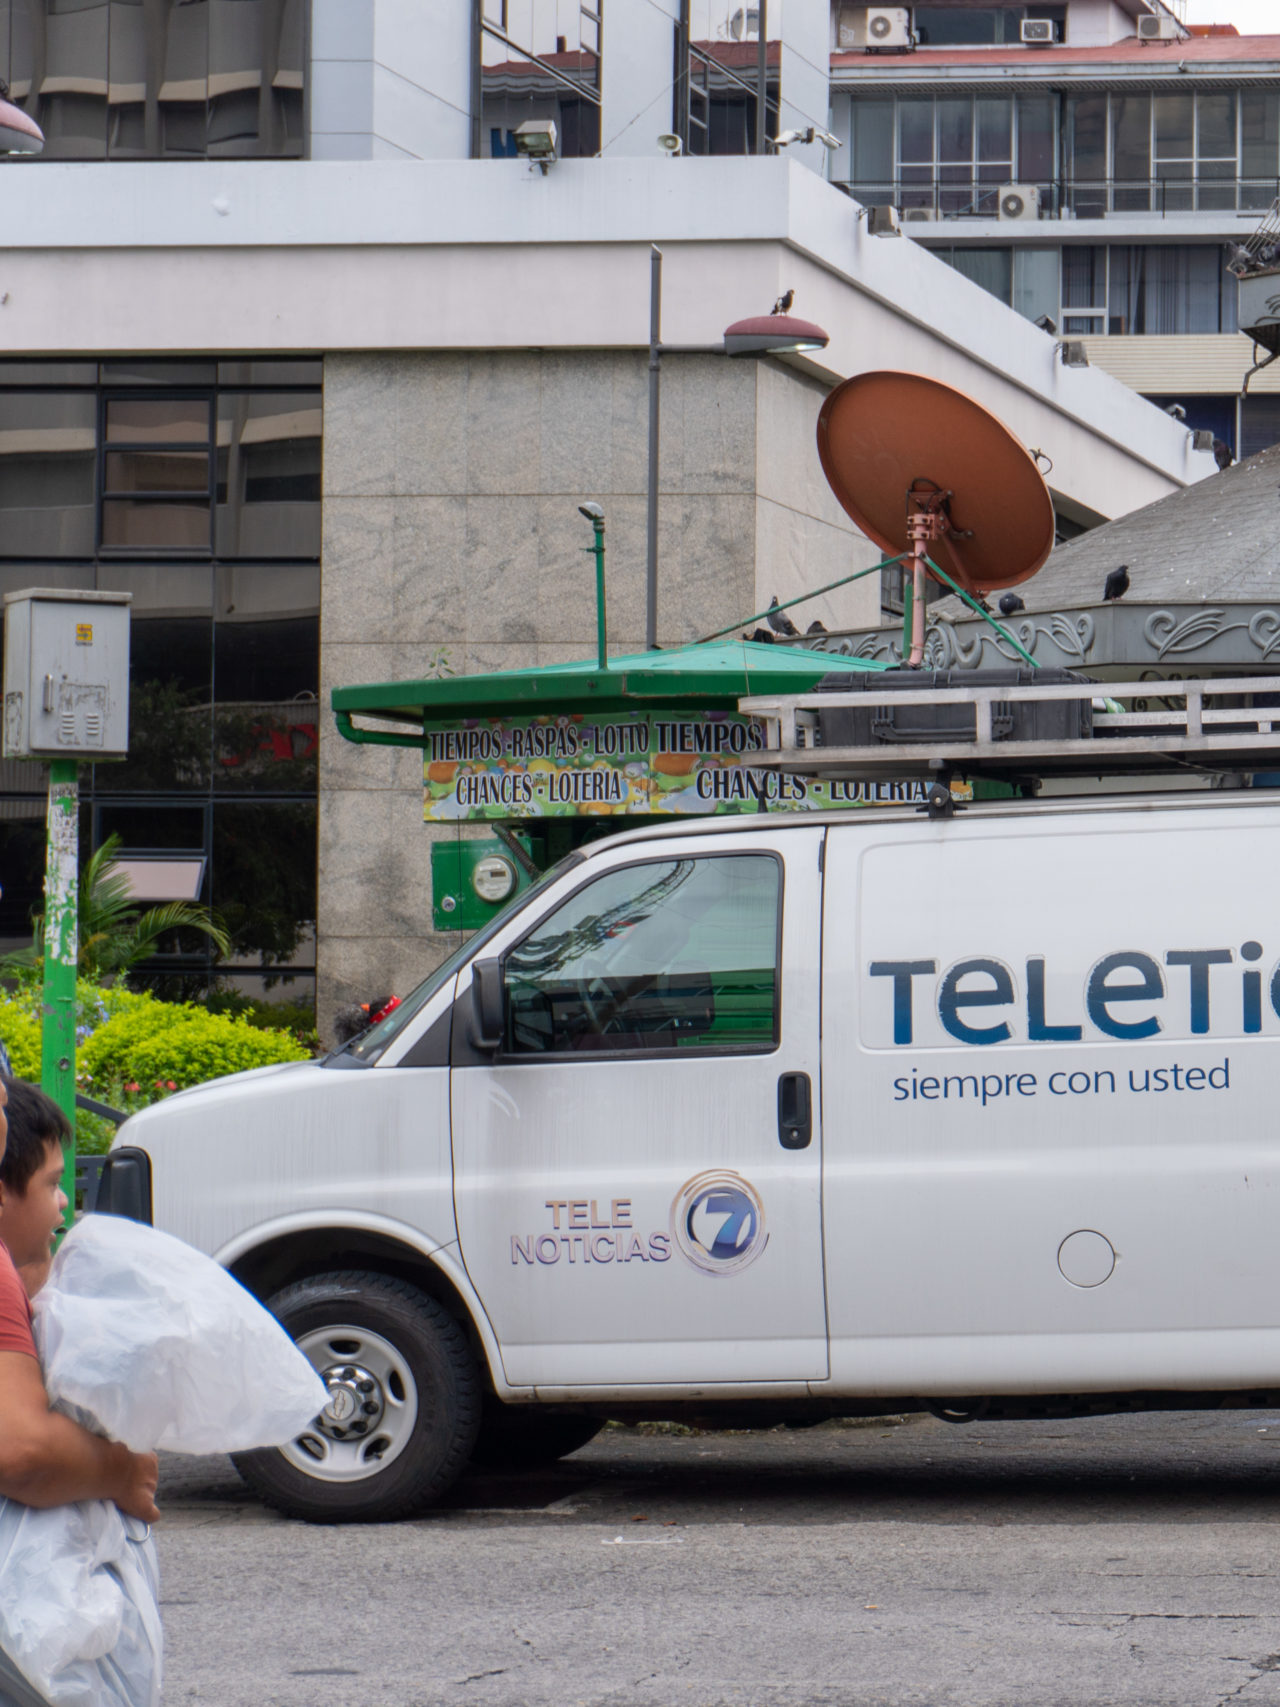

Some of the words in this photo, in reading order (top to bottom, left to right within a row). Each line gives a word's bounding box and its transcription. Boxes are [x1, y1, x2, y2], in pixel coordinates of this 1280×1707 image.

[429, 729, 502, 761] TIEMPOS
[594, 722, 650, 755] LOTTO
[654, 721, 763, 753] TIEMPOS
[456, 774, 533, 806] CHANCES
[548, 770, 622, 802] LOTERIA
[696, 768, 808, 801] CHANCES
[893, 1067, 1037, 1107] siempre
[1048, 1069, 1116, 1095] con
[1128, 1057, 1230, 1092] usted
[545, 1198, 633, 1230] TELE
[510, 1231, 672, 1265] NOTICIAS
